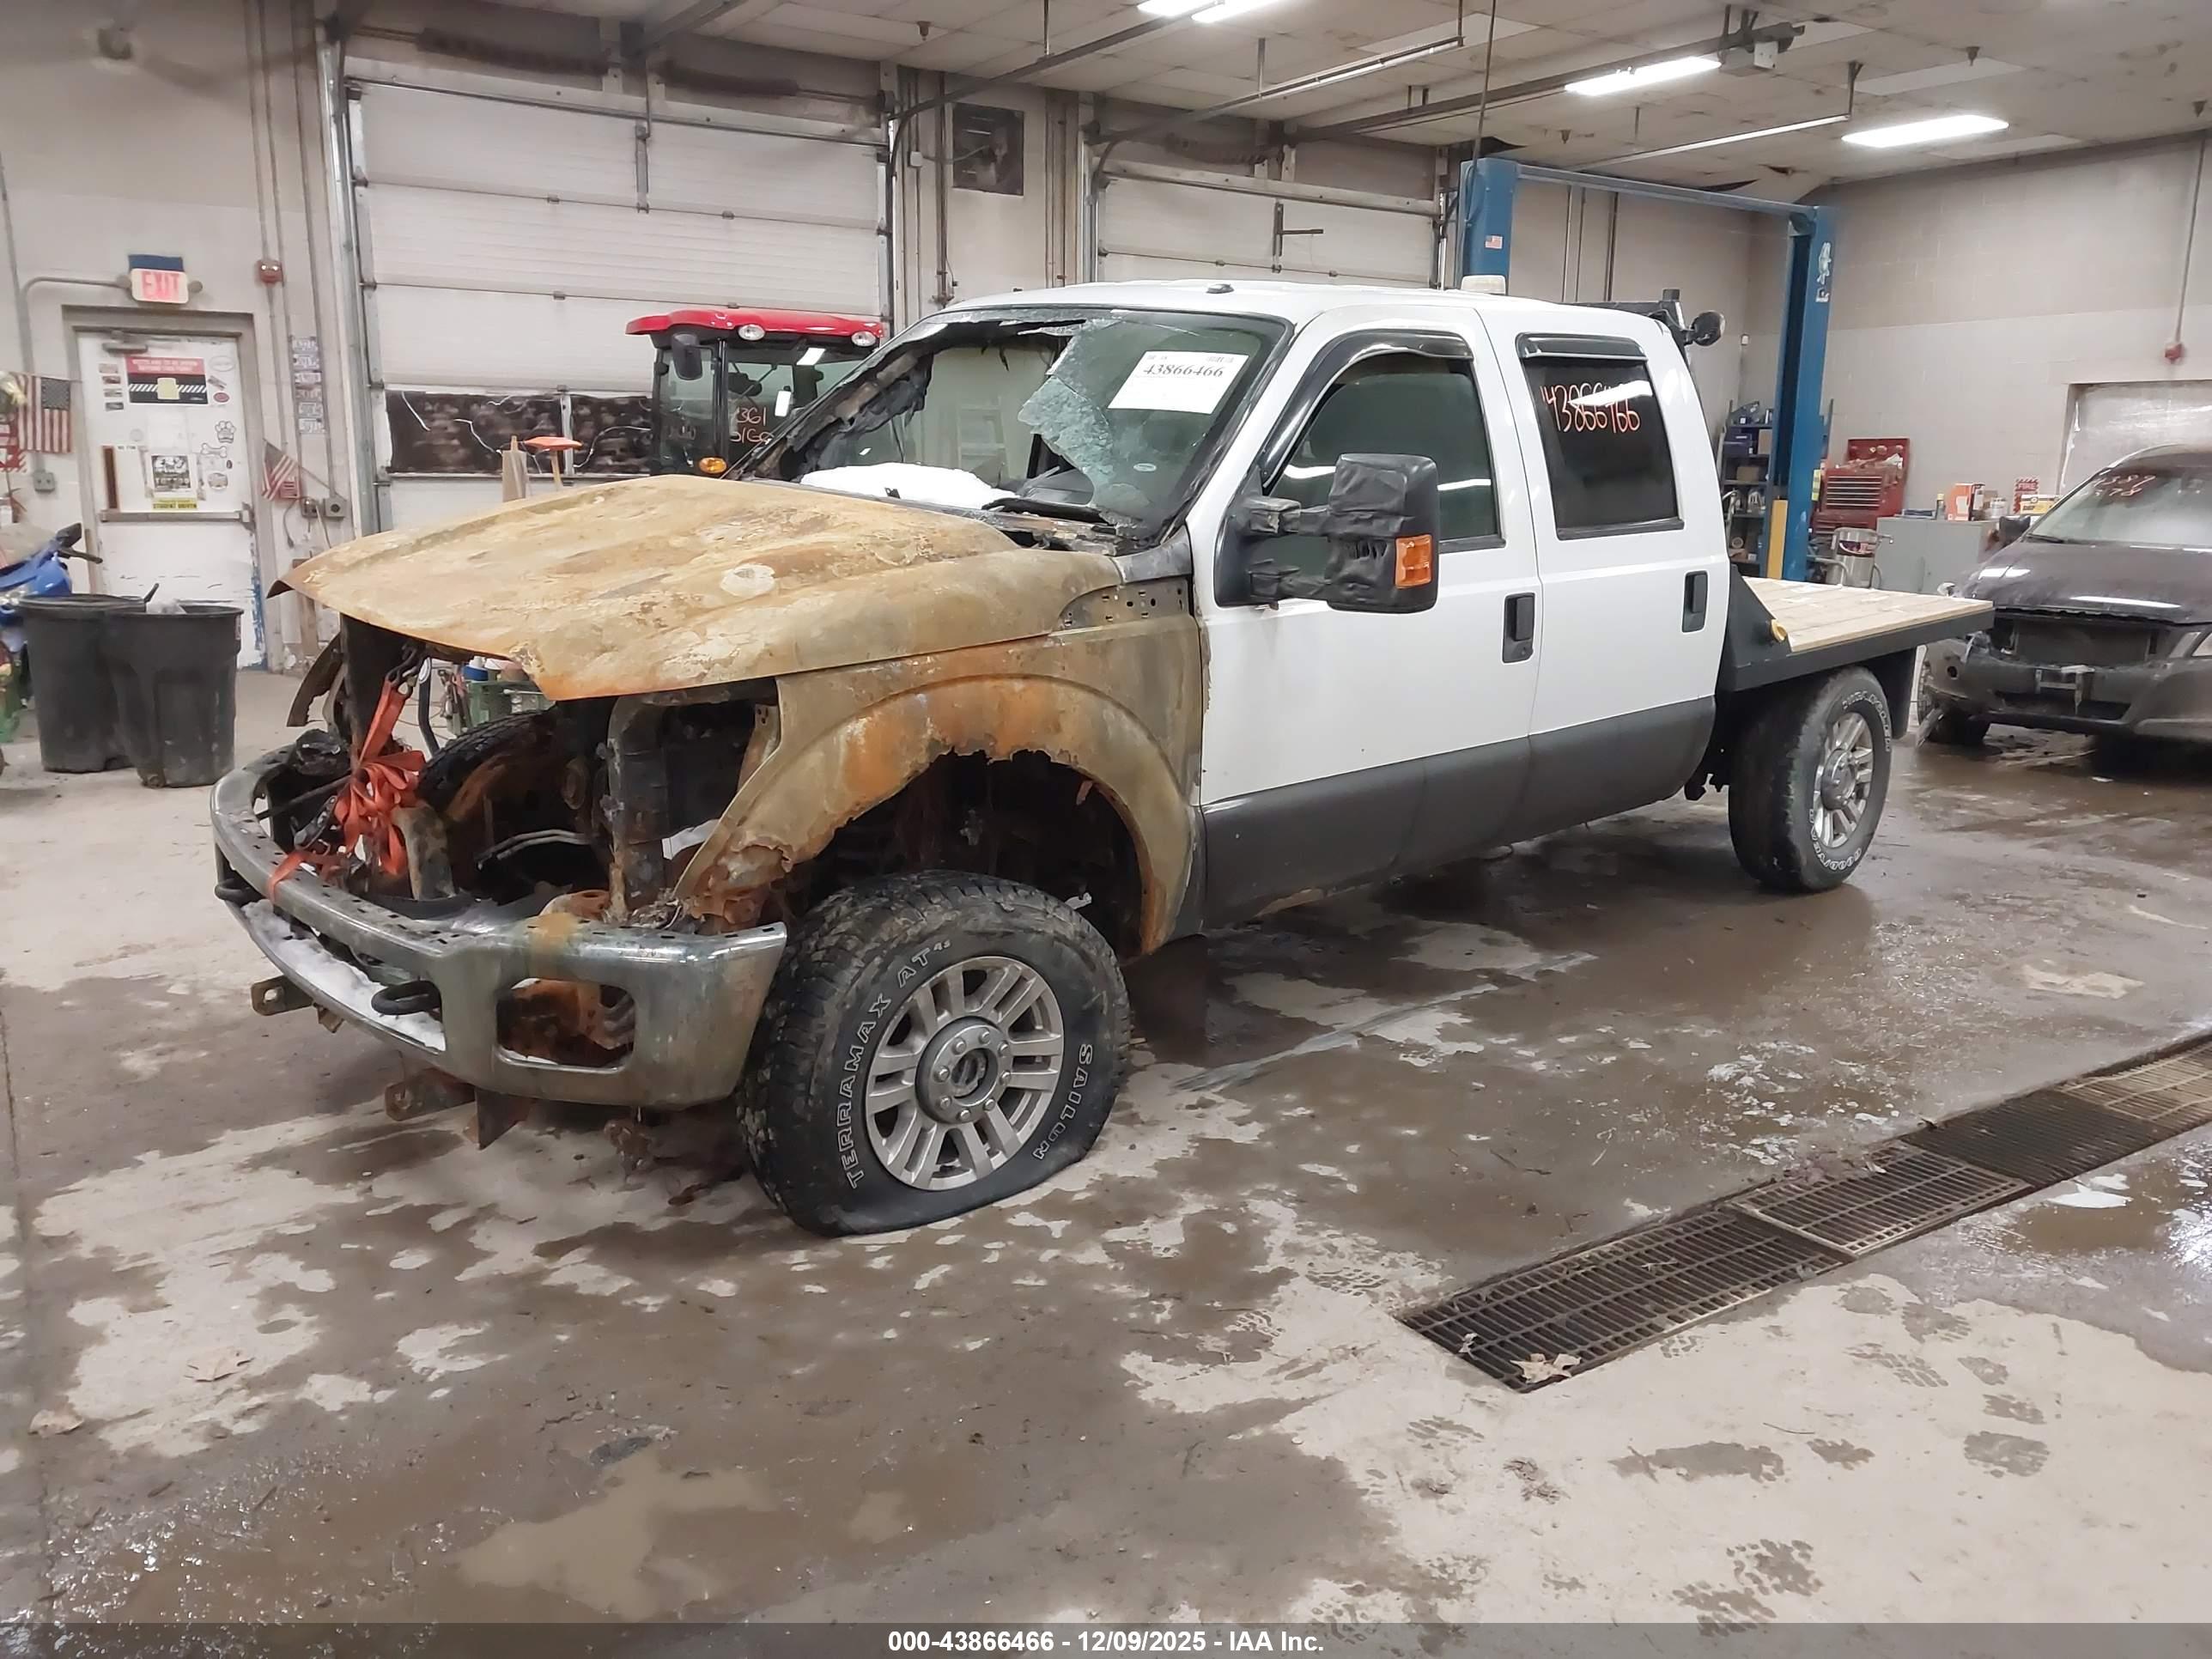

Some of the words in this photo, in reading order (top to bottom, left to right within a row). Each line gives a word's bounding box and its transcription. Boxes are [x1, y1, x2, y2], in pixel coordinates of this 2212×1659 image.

[142, 271, 179, 299] EXIT
[1143, 363, 1225, 378] 43866466
[837, 993, 891, 1188] TERRAMAX
[1032, 1043, 1093, 1159] SAILUN
